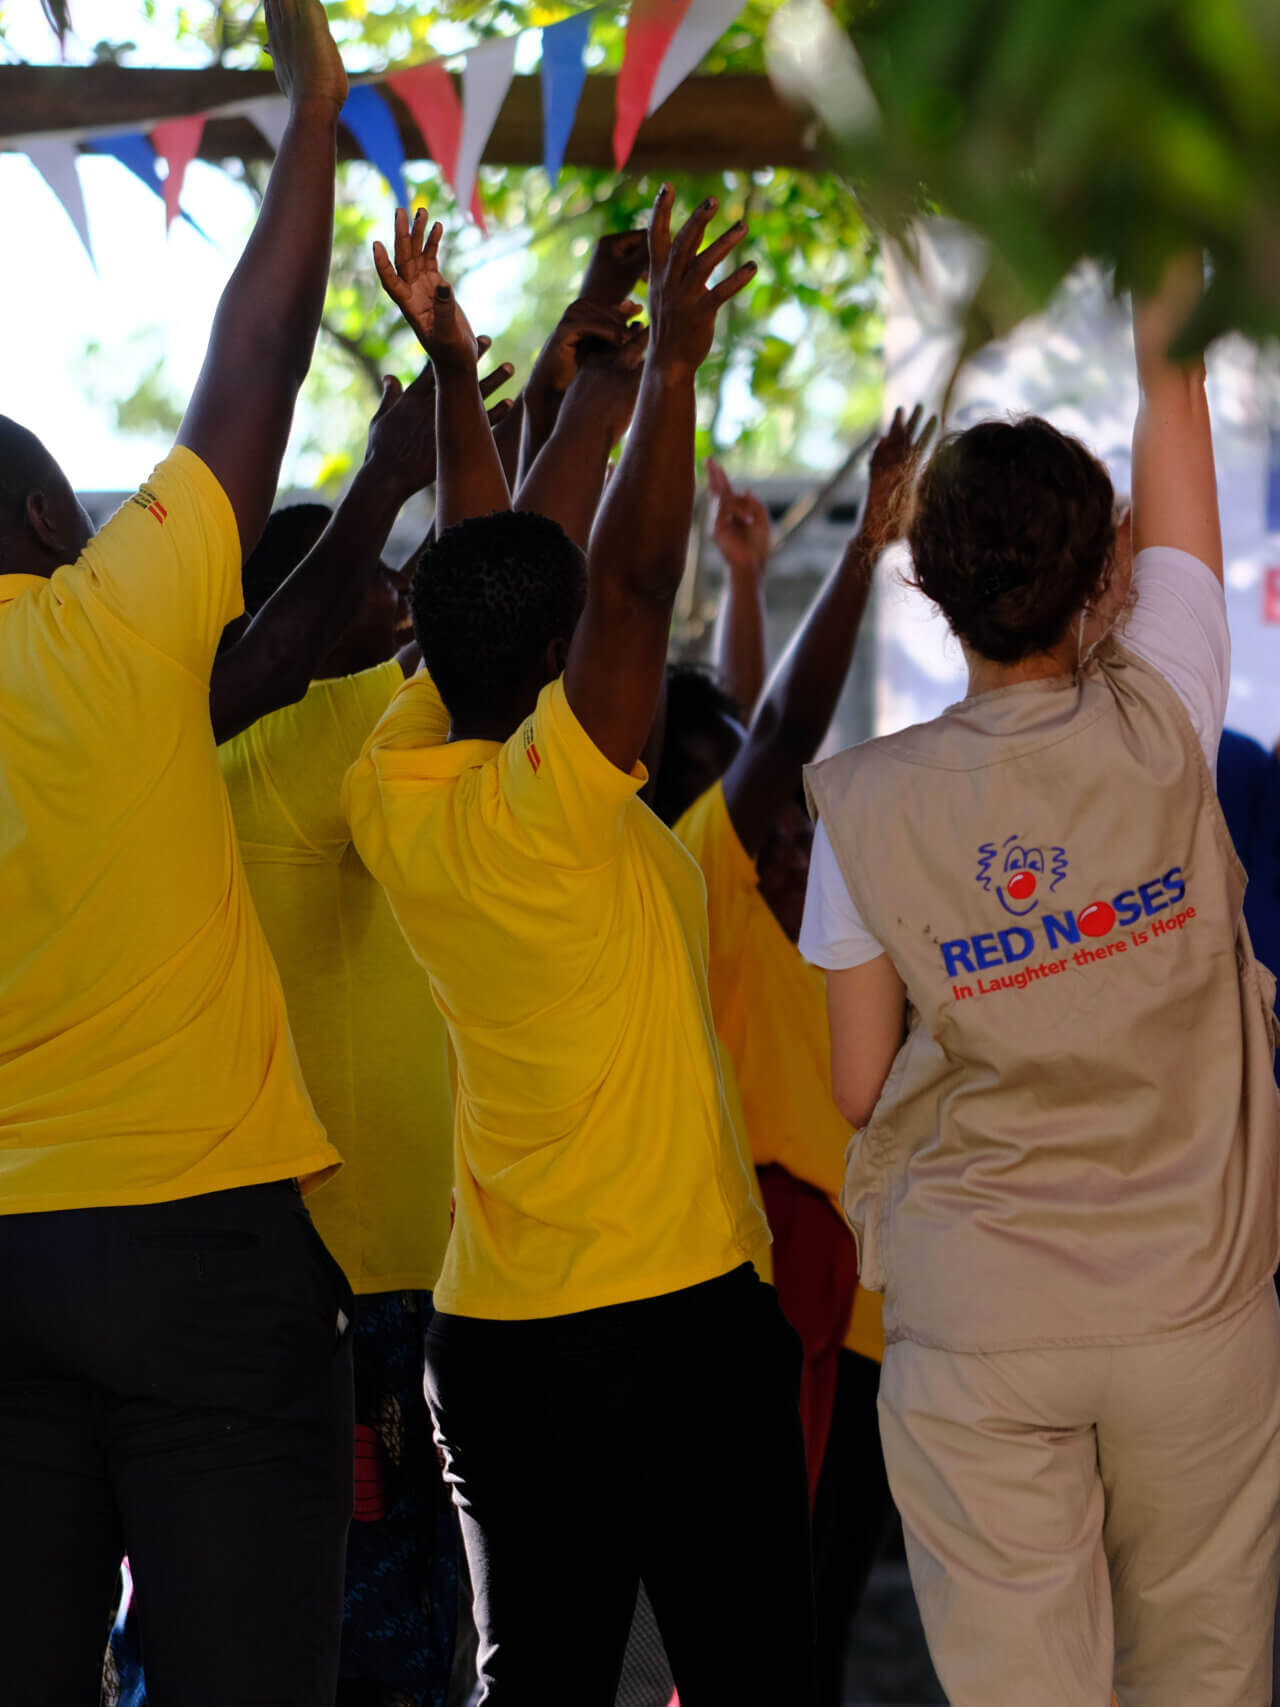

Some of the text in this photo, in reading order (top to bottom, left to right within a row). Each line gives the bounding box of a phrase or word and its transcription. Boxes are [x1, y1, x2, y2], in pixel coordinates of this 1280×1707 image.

[940, 867, 1186, 978] RED NOSES
[953, 906, 1197, 1001] In Laughter there is Hope
